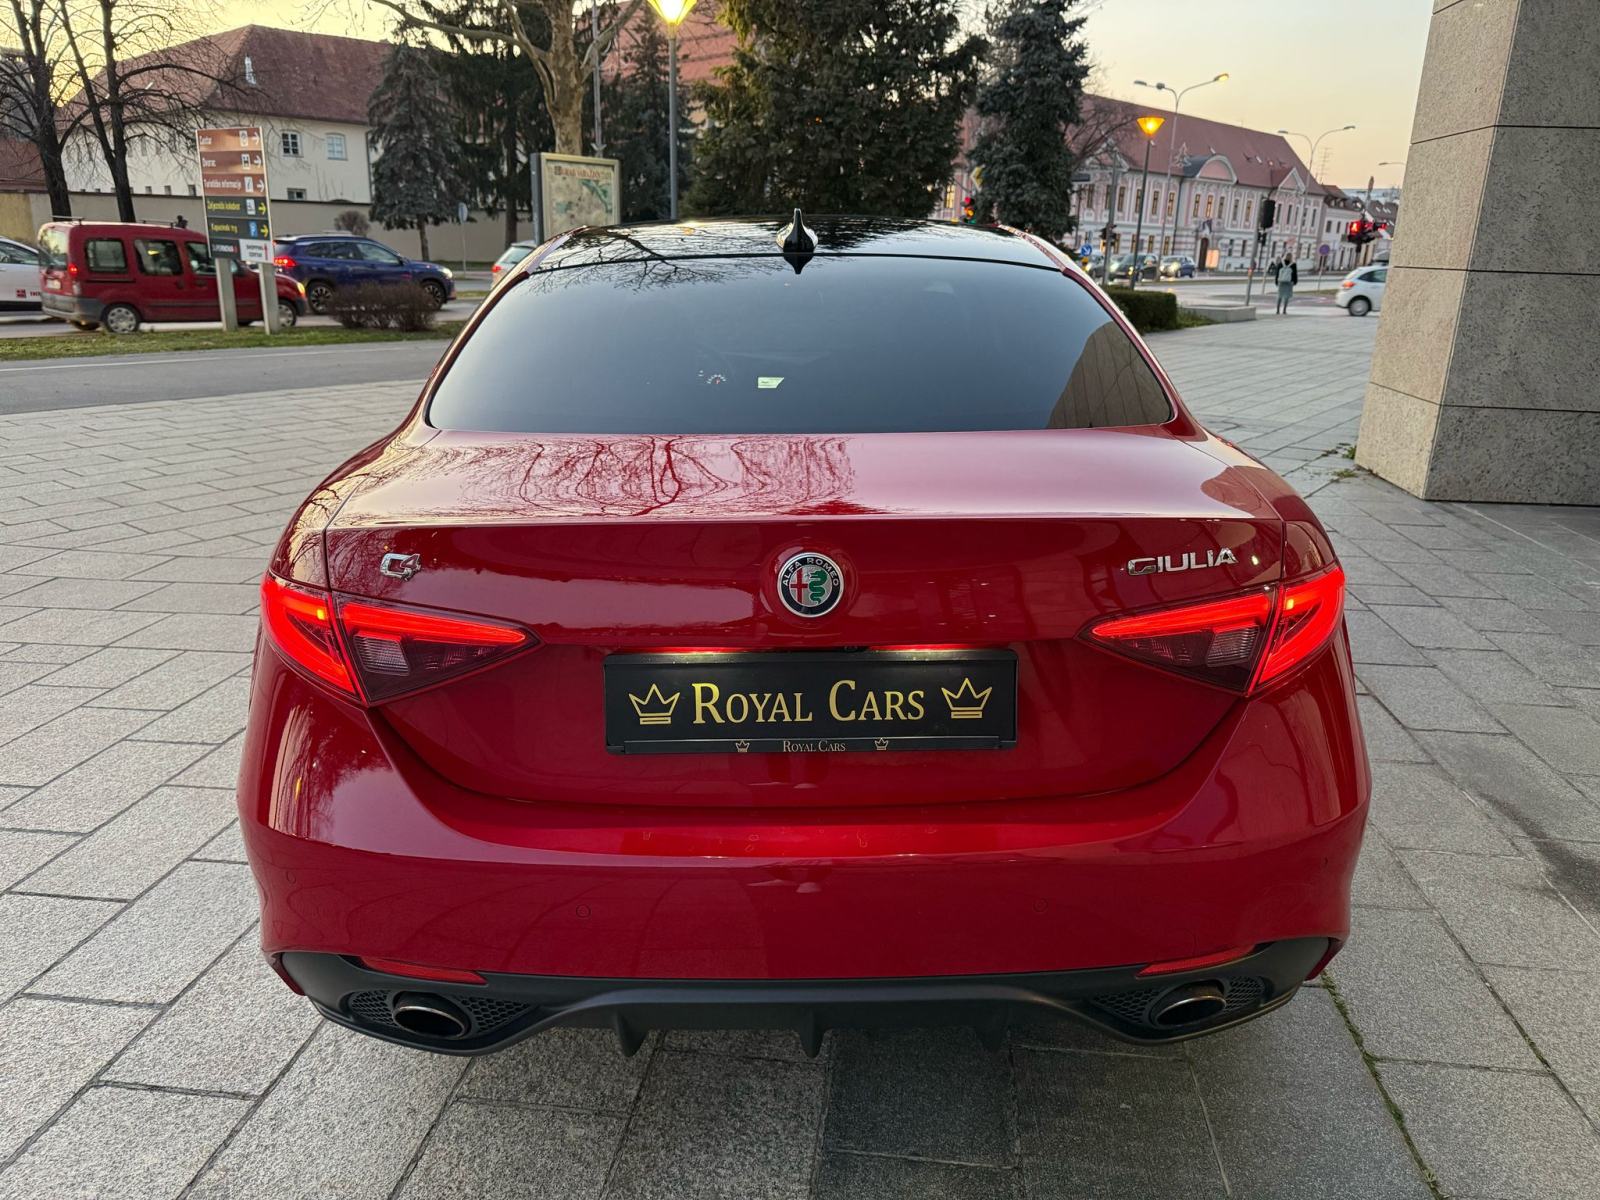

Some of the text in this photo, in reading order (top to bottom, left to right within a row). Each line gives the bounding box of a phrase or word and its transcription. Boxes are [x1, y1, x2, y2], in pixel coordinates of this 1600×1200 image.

[782, 557, 840, 587] ALFA ROMEO
[1127, 547, 1239, 576] GIULIA
[692, 679, 925, 725] ROYAL CARS
